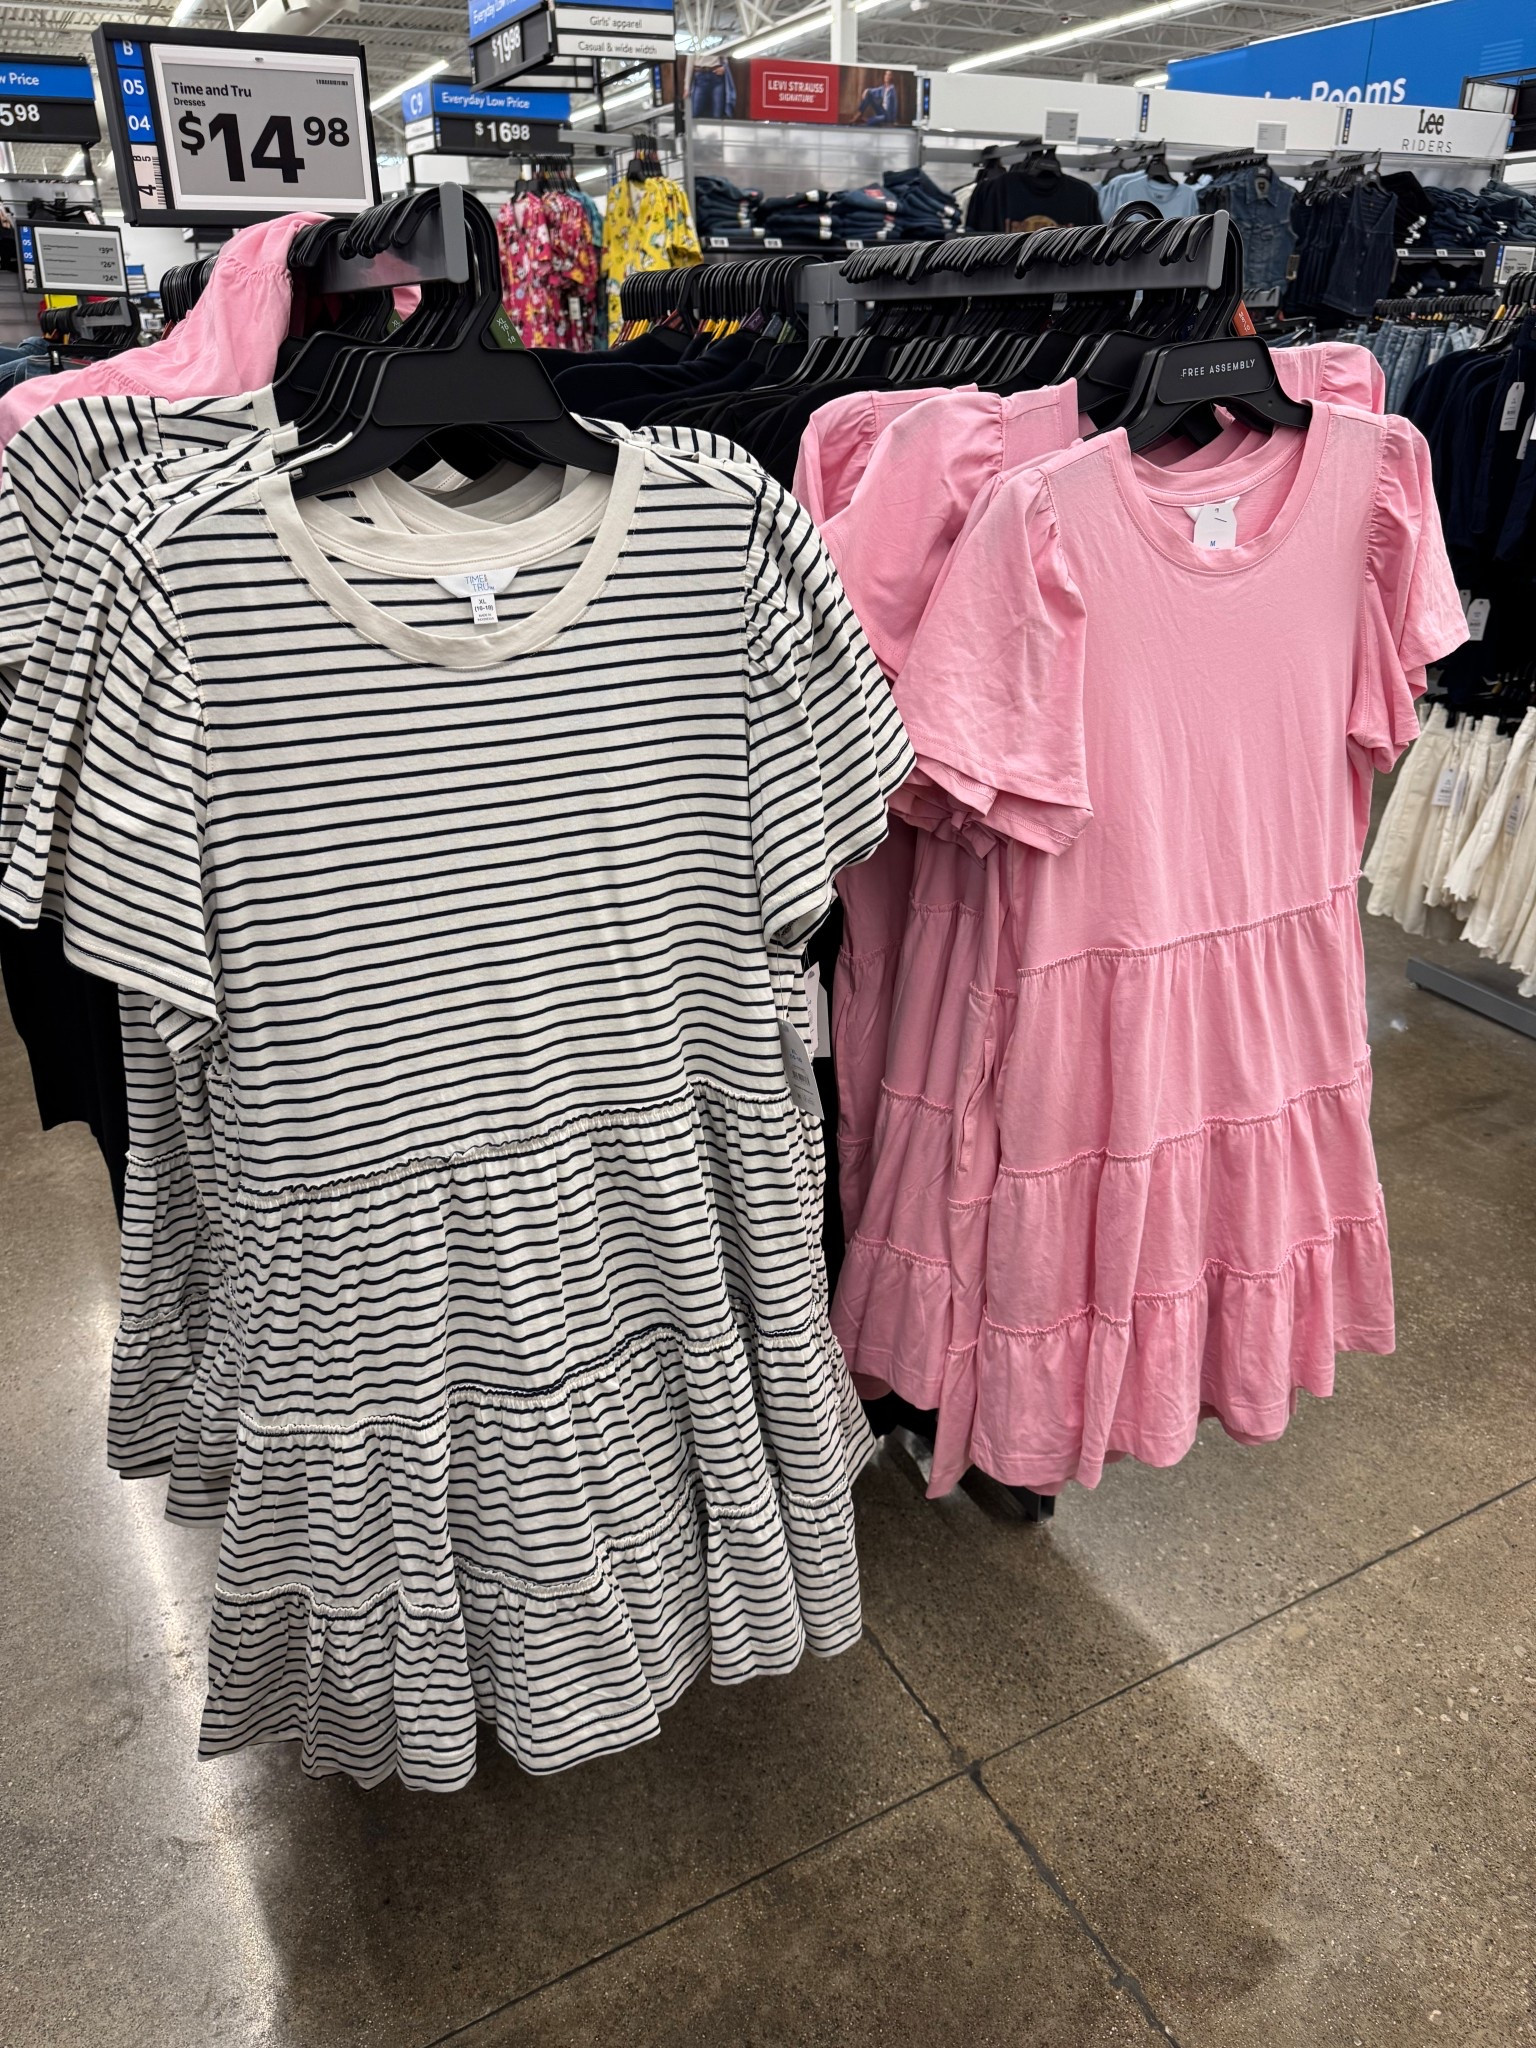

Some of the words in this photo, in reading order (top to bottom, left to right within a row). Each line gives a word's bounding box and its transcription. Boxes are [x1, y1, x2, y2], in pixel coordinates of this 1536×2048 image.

[612, 19, 642, 30] apparel
[122, 40, 133, 56] B
[492, 25, 521, 63] $1998
[9, 72, 40, 86] Price
[768, 80, 787, 91] LEVI
[788, 81, 824, 94] STRAUSS
[123, 79, 145, 96] 05
[171, 82, 204, 96] Time
[205, 83, 229, 97] and
[230, 85, 252, 98] Tru
[173, 97, 206, 107] Dresses
[409, 92, 423, 115] C9
[442, 92, 485, 109] Everyday
[486, 95, 505, 107] Low
[506, 97, 530, 109] Price
[128, 115, 151, 131] 04
[1417, 108, 1444, 135] Lee
[1401, 138, 1452, 153] RIDERS
[1182, 366, 1205, 378] FREE
[1209, 358, 1256, 374] ASSEMBLY
